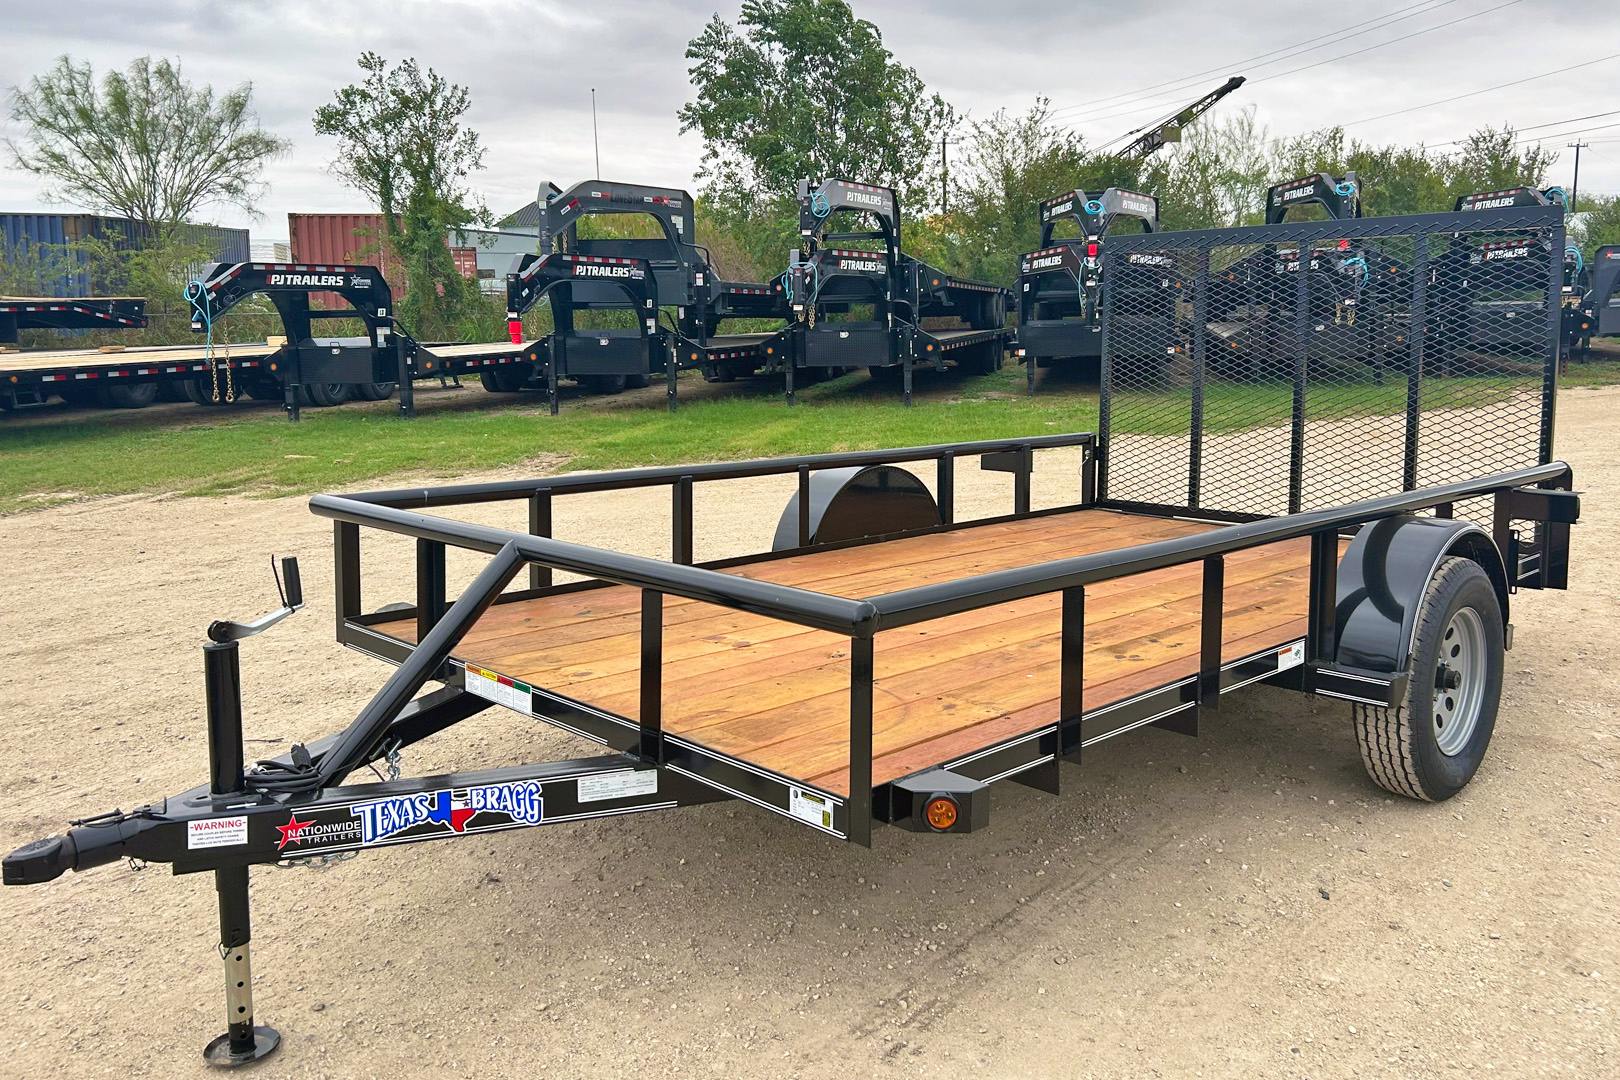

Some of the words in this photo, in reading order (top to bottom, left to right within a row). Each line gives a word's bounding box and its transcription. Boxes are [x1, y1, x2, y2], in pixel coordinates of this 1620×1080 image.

[352, 794, 430, 844] TEXAS
[470, 781, 544, 825] BRAGG
[287, 820, 361, 838] NATIONWIDE
[307, 831, 362, 845] TRAILERS
